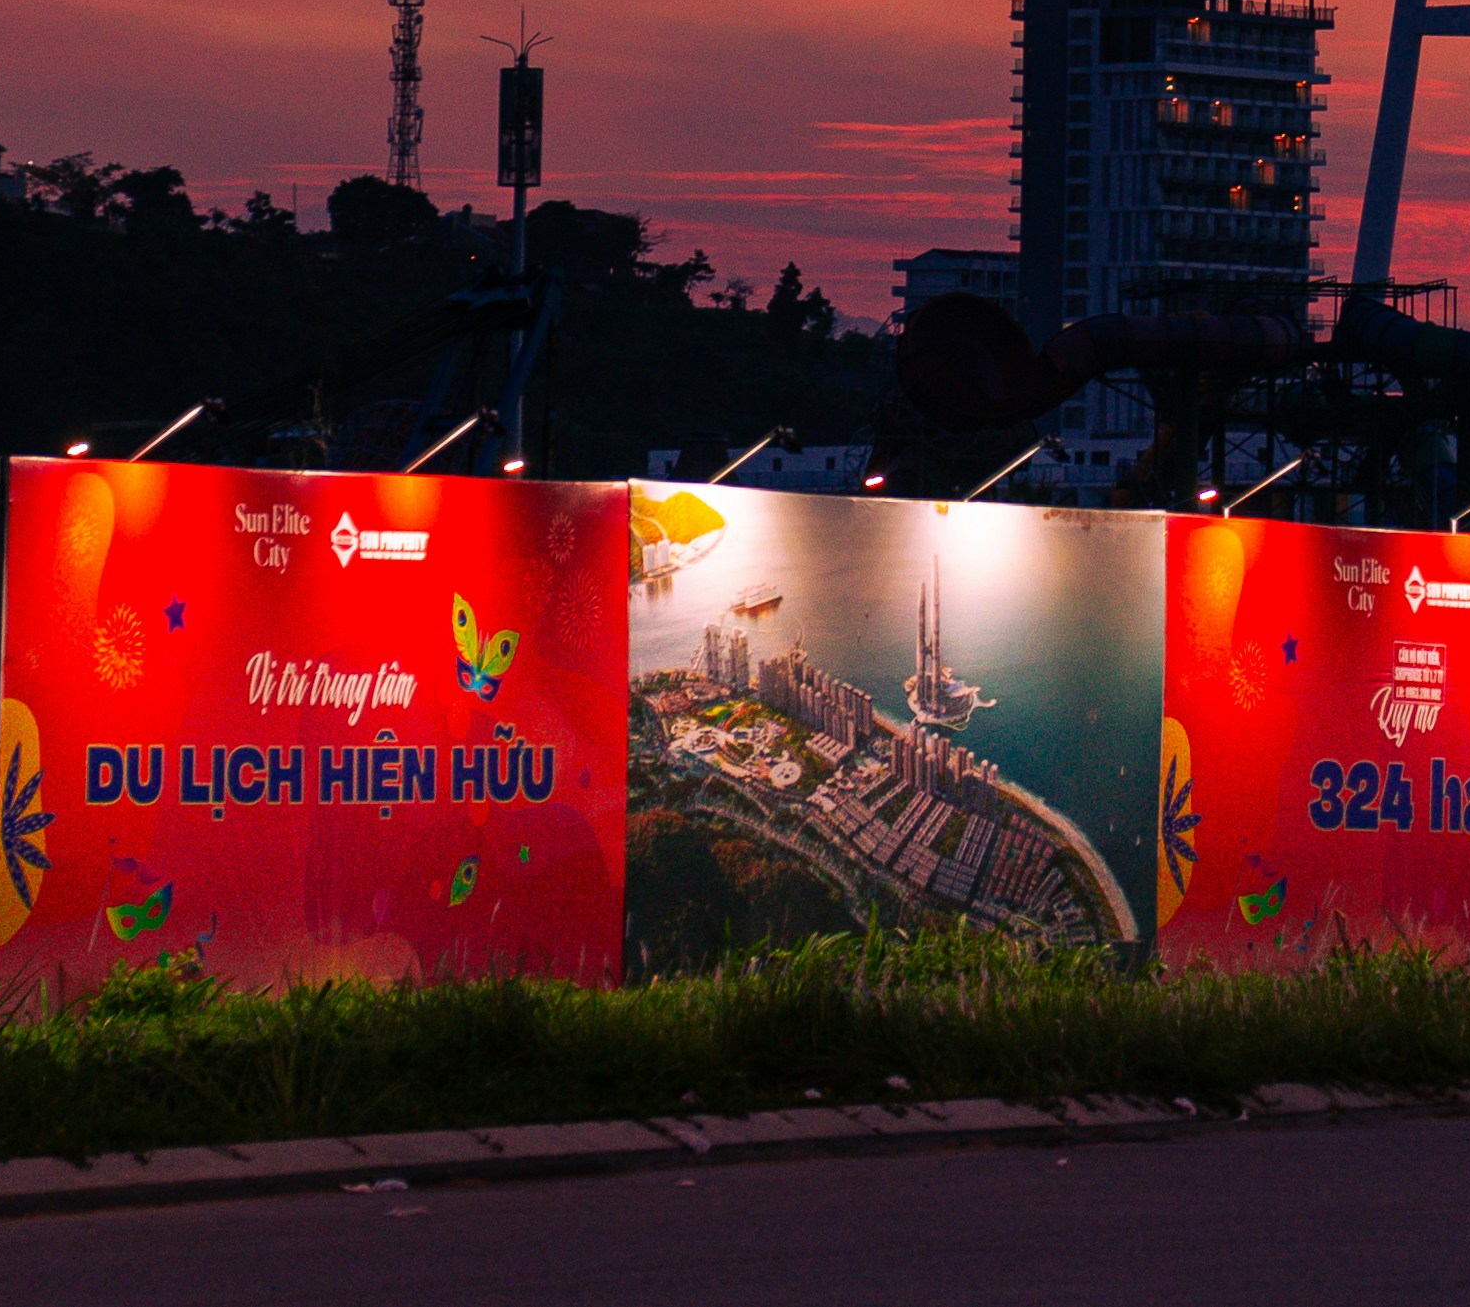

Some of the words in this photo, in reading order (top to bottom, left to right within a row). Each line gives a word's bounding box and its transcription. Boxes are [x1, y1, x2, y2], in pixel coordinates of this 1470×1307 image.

[235, 503, 269, 533] Sun
[272, 504, 311, 535] Elite
[253, 537, 290, 574] City
[360, 531, 379, 550] SUN
[380, 531, 429, 551] PROPERTY
[1334, 556, 1359, 583] Sun
[1361, 558, 1390, 584] Elite
[1348, 586, 1375, 618] City
[246, 650, 277, 716] Vị
[276, 658, 313, 707] trí
[309, 662, 373, 726] trung
[371, 661, 418, 710] tâm
[85, 743, 164, 806] DU
[178, 744, 304, 820] LỊCH
[318, 728, 436, 820] HIỆN
[451, 721, 555, 805] HỮU
[1309, 758, 1414, 831] 324
